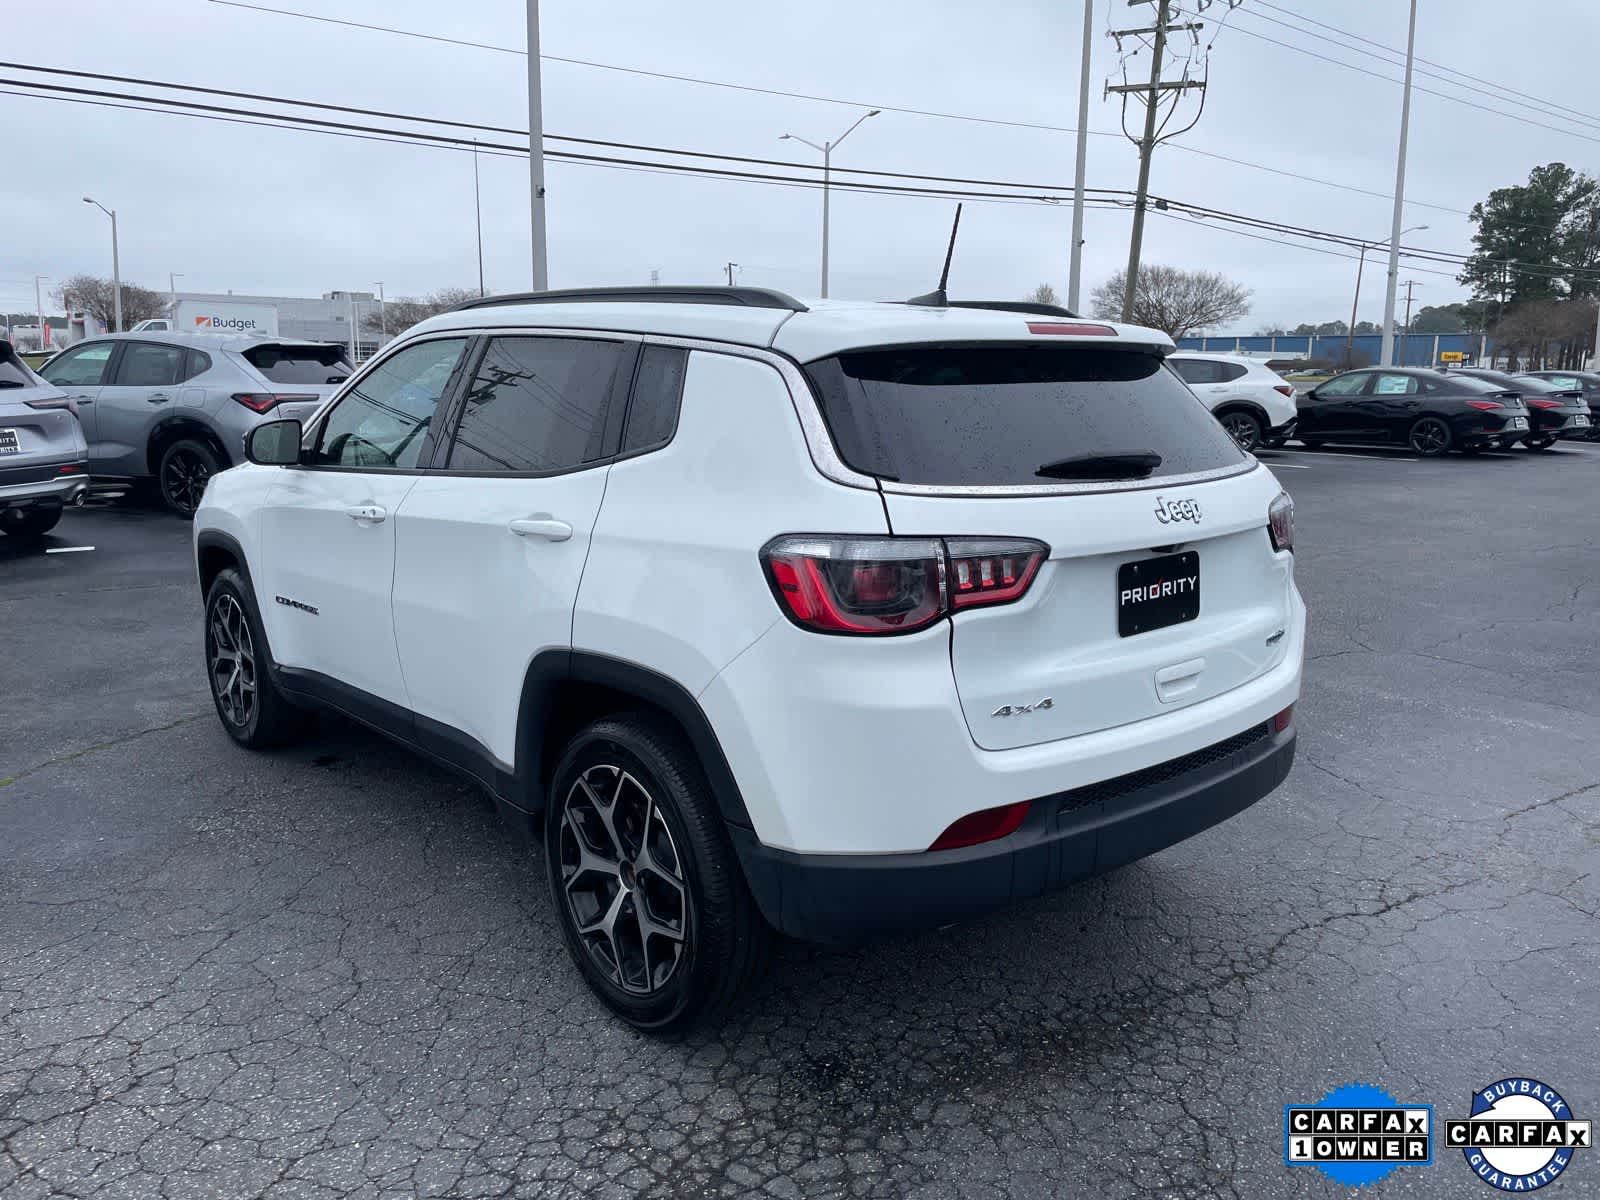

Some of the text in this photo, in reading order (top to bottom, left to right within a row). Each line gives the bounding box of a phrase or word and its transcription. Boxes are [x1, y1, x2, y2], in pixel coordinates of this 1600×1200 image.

[212, 316, 256, 332] Budget
[1154, 495, 1203, 525] Jeep
[1120, 575, 1198, 606] PRIORITY
